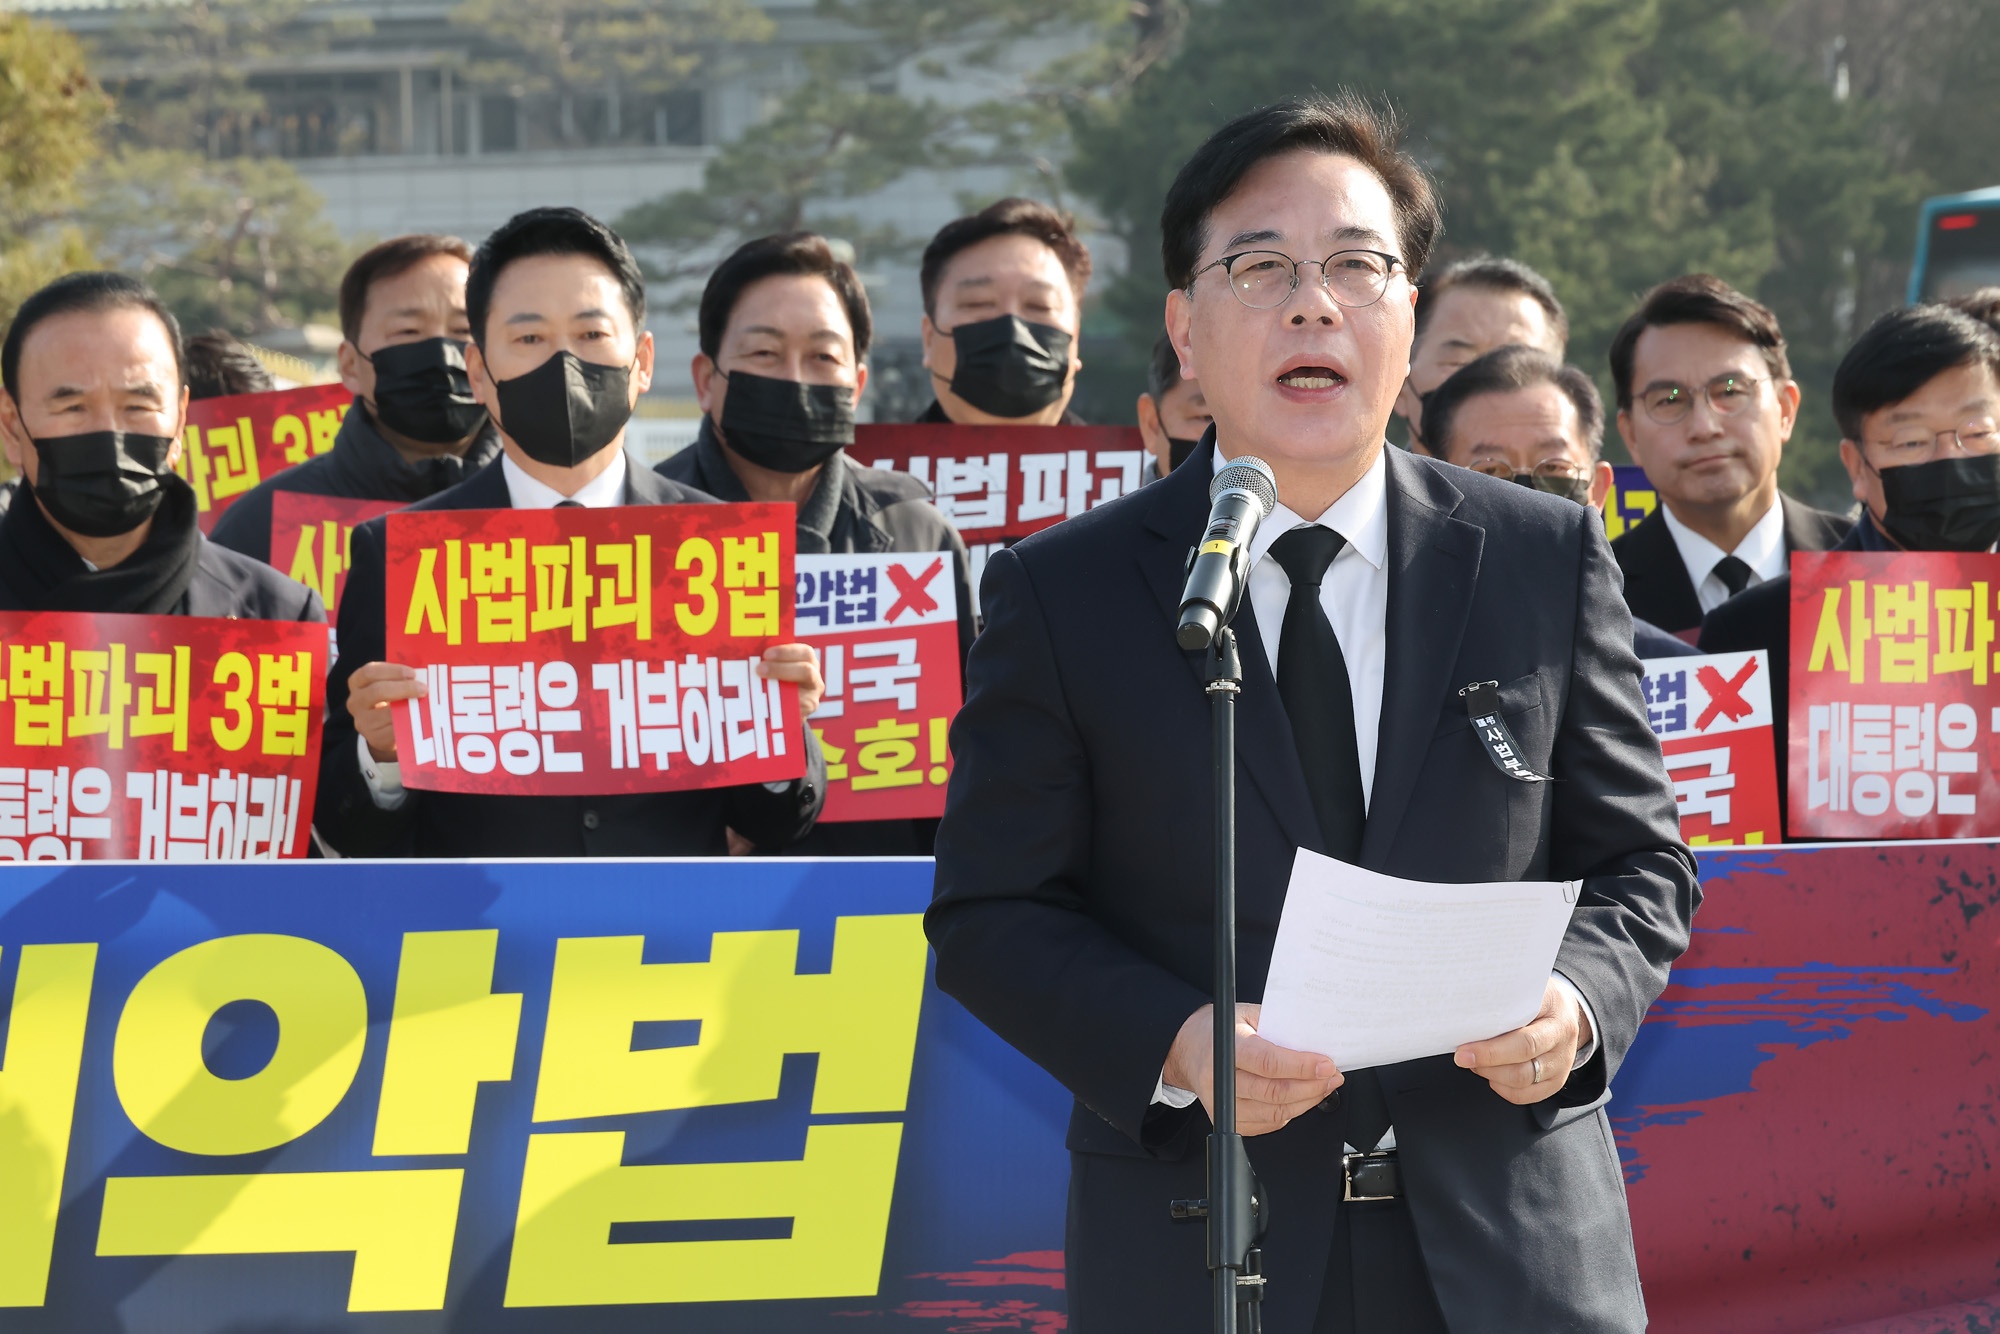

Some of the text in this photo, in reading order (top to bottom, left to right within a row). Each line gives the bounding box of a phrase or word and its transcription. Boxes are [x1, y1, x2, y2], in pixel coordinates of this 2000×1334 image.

[289, 520, 353, 611] 사
[404, 532, 780, 645] 사법파괴 3법
[795, 567, 877, 626] 악법
[1807, 580, 2000, 685] 사법파
[0, 641, 312, 756] 법파괴 3법
[408, 654, 786, 775] 대통령은 거부하라!
[126, 768, 302, 860] 거부하라!
[1808, 702, 1978, 817] 대통령은
